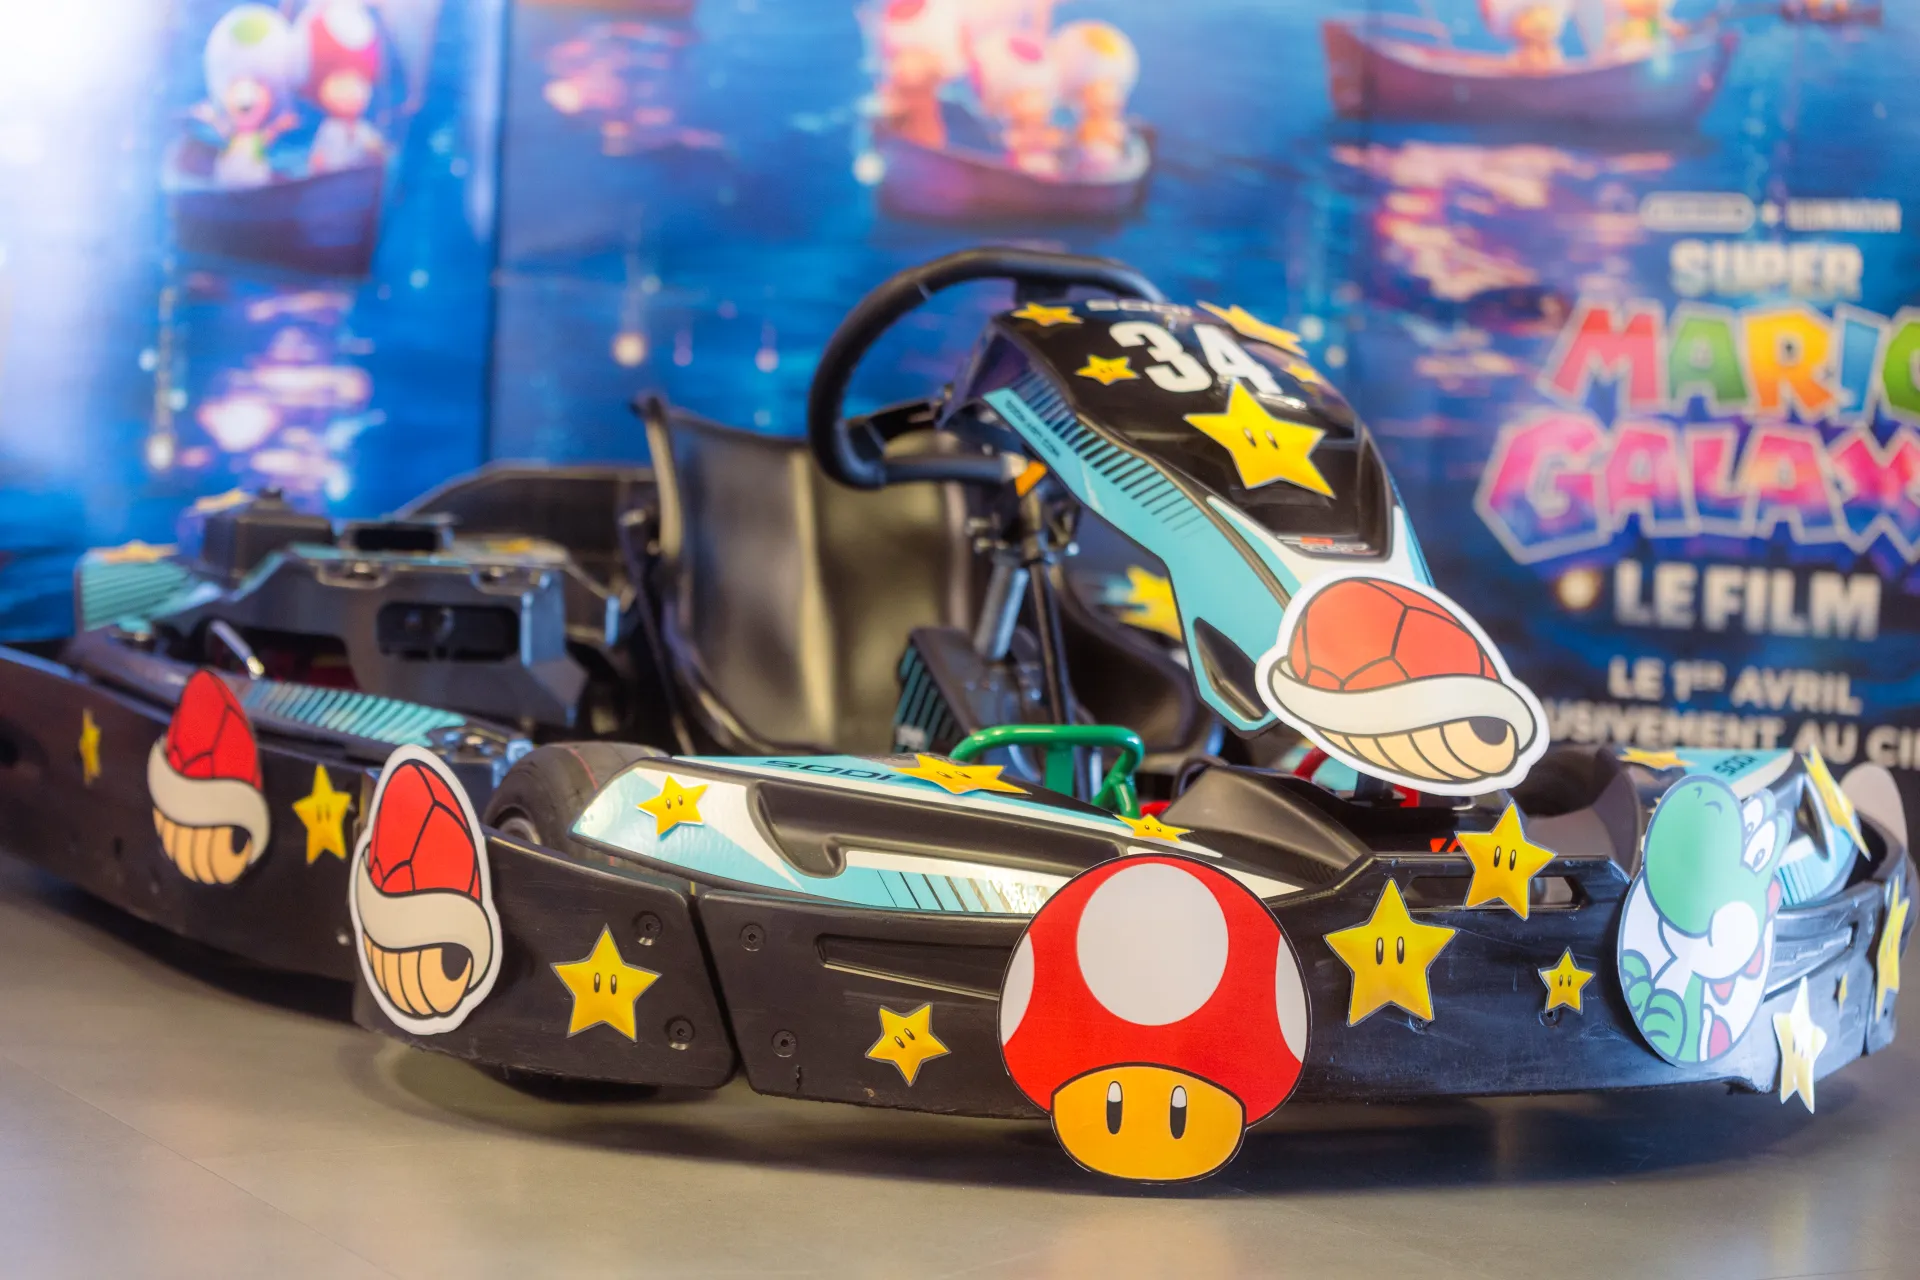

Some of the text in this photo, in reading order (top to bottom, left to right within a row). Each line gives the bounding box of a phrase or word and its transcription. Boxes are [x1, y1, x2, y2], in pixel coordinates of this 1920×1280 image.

[1670, 238, 1863, 301] SUPER
[1109, 320, 1284, 394] 34
[1614, 559, 1881, 641] LE FILM
[1608, 654, 1666, 700] LE
[1730, 664, 1863, 717] AVRIL
[760, 760, 896, 781] SODI
[1793, 719, 1859, 765] AU
